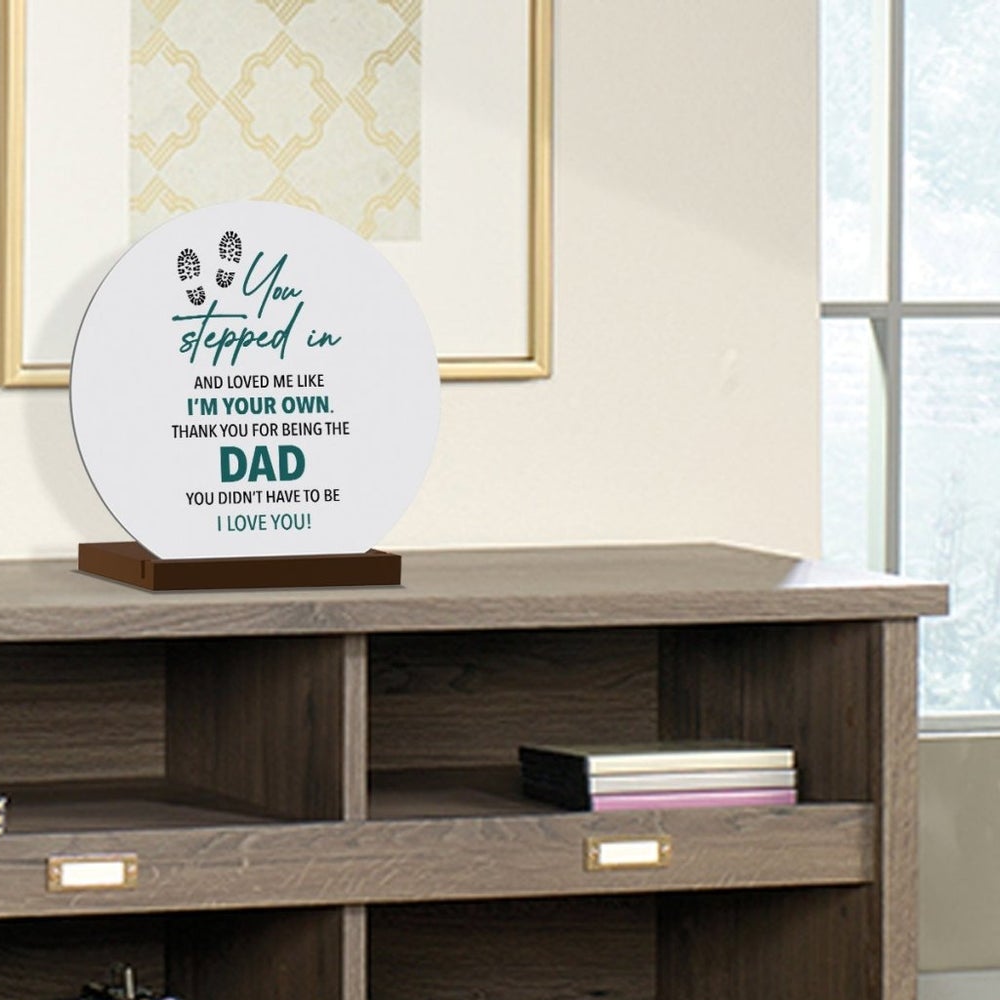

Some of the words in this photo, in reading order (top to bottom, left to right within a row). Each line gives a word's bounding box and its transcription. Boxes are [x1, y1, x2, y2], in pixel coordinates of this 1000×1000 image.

[242, 251, 303, 319] You
[171, 299, 305, 367] stepped
[306, 329, 342, 348] in
[193, 375, 224, 390] AND
[227, 374, 270, 390] LOVED
[273, 374, 294, 389] ME
[297, 373, 325, 388] LIKE
[187, 397, 218, 416] I'M
[221, 396, 277, 416] YOUR
[281, 395, 335, 415] OWN.
[171, 424, 218, 439] THANK
[219, 423, 249, 438] YOU
[251, 422, 279, 438] FOR
[281, 422, 323, 437] BEING
[324, 421, 351, 436] THE
[219, 444, 306, 484] DAD
[185, 491, 215, 506] YOU
[218, 490, 263, 505] DIDN'T
[265, 489, 301, 504] HAVE
[302, 488, 321, 503] TO
[323, 488, 341, 502] BE
[217, 515, 222, 532] I
[227, 514, 267, 532] LOVE
[270, 512, 312, 531] YOU!
